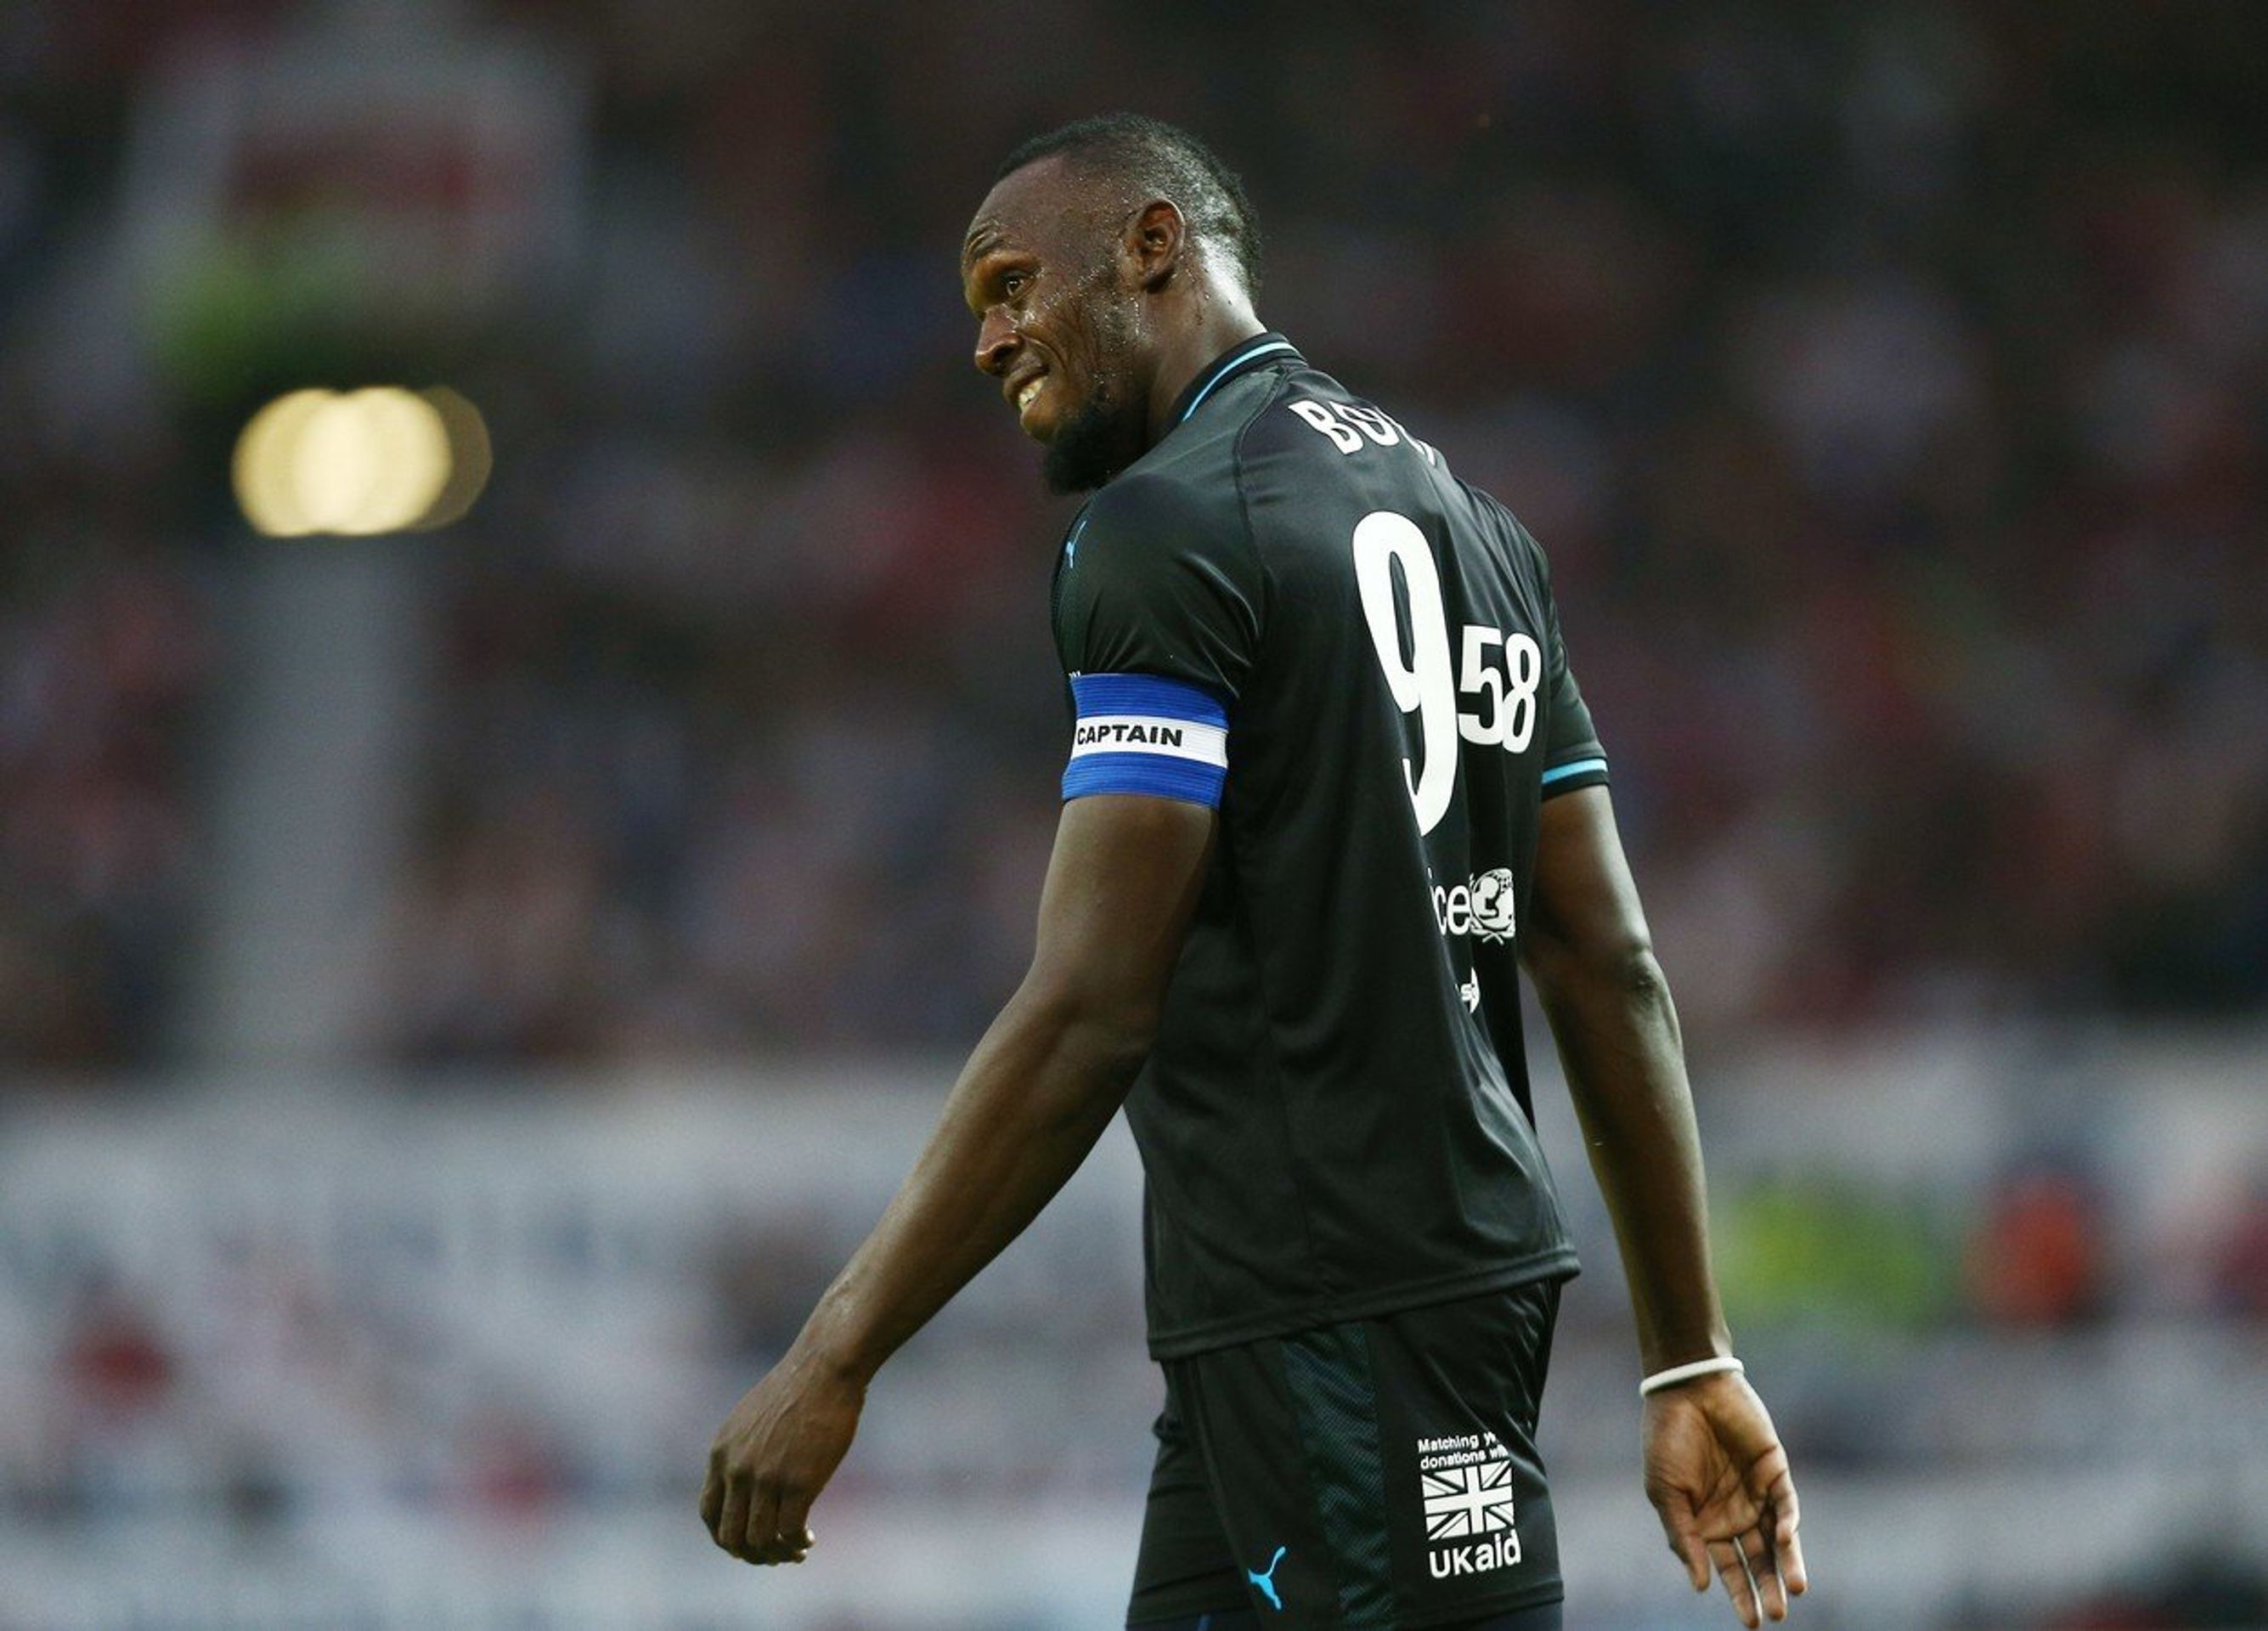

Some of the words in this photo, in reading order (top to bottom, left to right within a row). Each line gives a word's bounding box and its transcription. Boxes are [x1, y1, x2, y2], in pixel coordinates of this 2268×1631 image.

[1352, 511, 1458, 837] 9
[1458, 624, 1542, 754] 58
[1077, 724, 1183, 748] CAPTAIN
[1418, 1434, 1479, 1453] Matching
[1420, 1449, 1487, 1470] donations
[1429, 1528, 1522, 1578] UKaid
